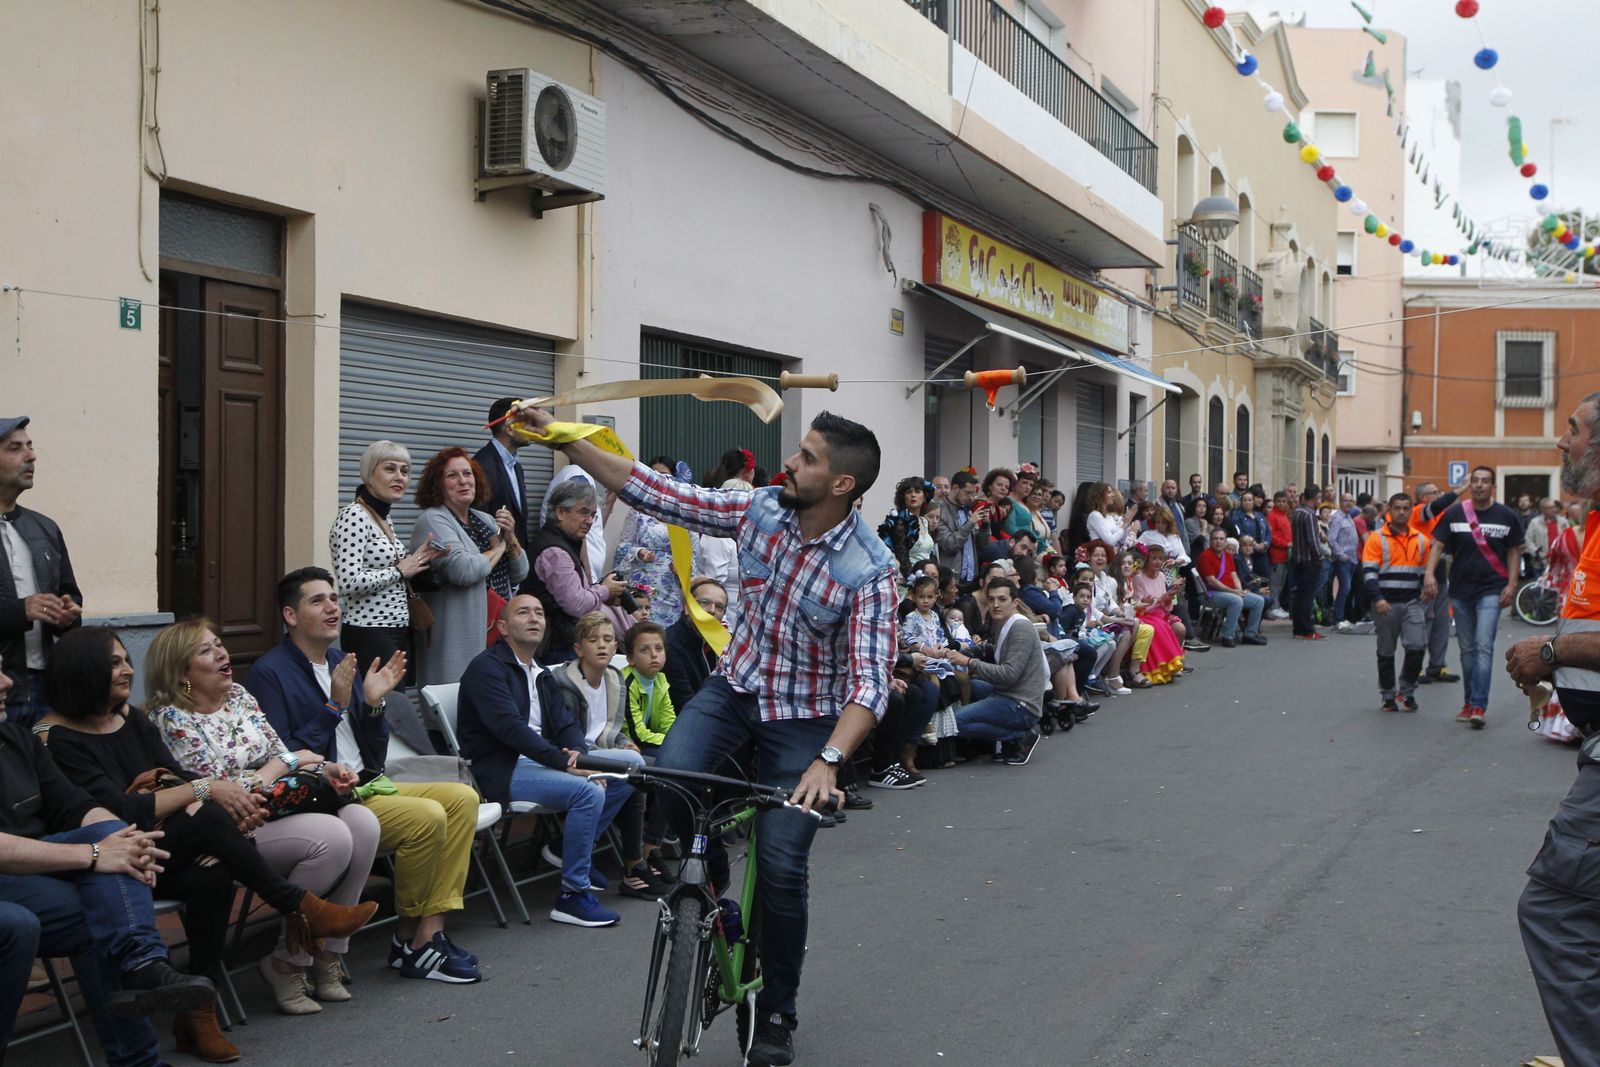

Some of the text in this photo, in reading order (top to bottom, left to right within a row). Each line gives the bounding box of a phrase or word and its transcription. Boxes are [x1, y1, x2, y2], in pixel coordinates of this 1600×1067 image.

[969, 234, 985, 293] El
[986, 245, 1021, 309] Corte
[1022, 261, 1056, 320] Chino
[126, 310, 135, 327] 5
[1452, 464, 1465, 485] P
